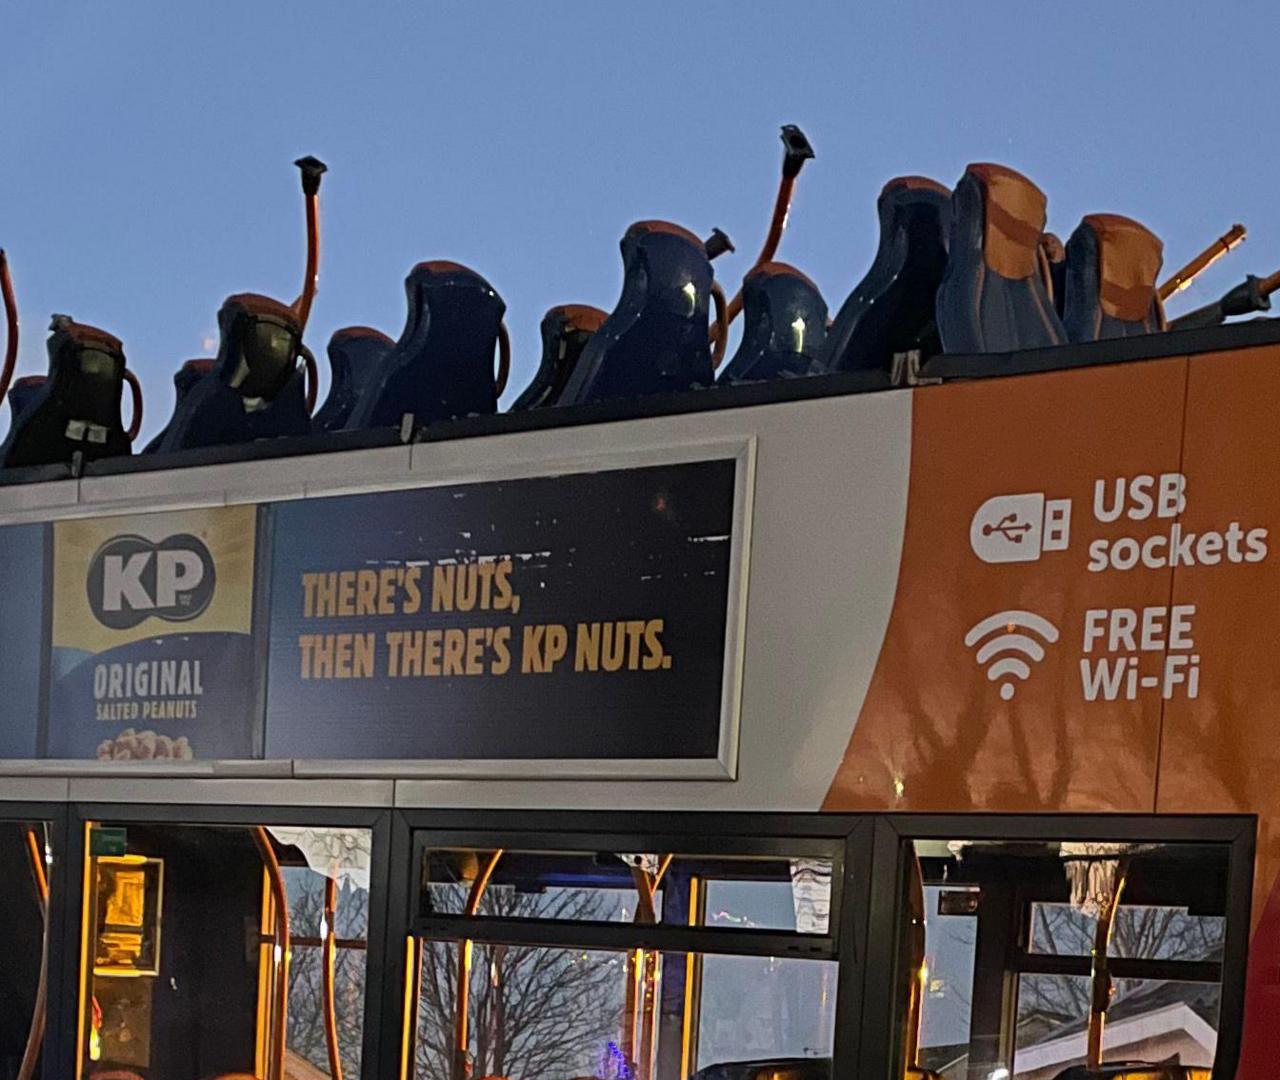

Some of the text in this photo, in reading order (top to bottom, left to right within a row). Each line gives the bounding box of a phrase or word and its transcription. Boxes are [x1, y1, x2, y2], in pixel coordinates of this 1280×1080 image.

[1093, 473, 1187, 523] USB
[1087, 522, 1268, 572] sockets
[103, 550, 204, 611] KP
[302, 560, 520, 617] THERE'S NUTS,
[299, 619, 672, 679] THEN THERE'S KP NUTS.
[1083, 605, 1196, 652] FREE
[94, 660, 203, 699] ORIGINAL
[1079, 655, 1200, 701] Wi-Fi
[96, 700, 197, 720] SALTED PEANUTS
